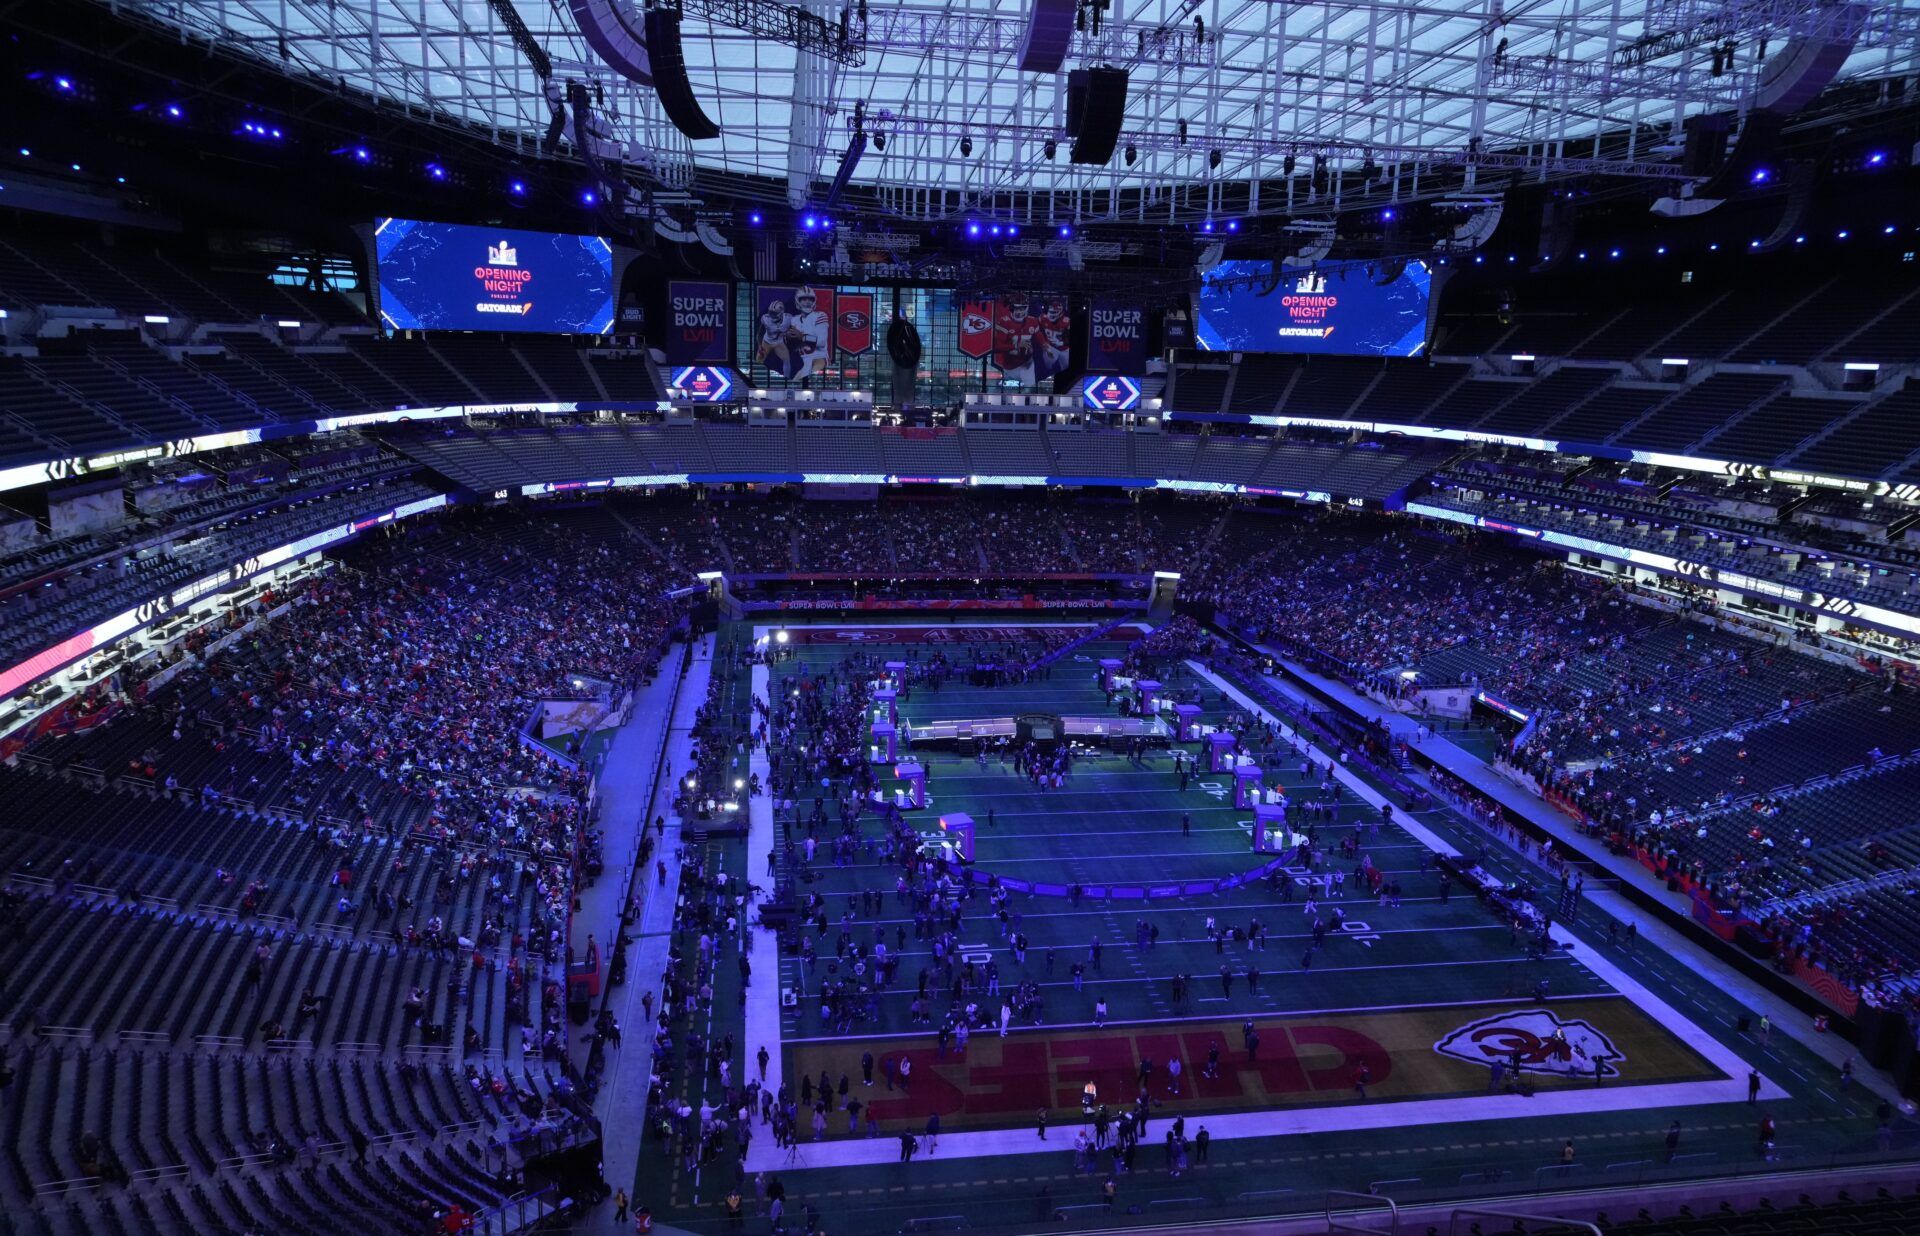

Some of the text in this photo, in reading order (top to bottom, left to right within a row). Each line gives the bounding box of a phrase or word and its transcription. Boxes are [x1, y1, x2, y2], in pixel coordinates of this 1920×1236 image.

[475, 267, 531, 281] OPENING
[485, 280, 522, 292] NIGHT
[673, 296, 725, 312] SUPER
[1282, 296, 1337, 307] OPENING
[476, 303, 523, 314] GATORADE
[1290, 306, 1327, 318] NIGHT
[674, 312, 724, 327] BOWL
[1092, 310, 1141, 324] SUPER
[682, 328, 715, 342] LVIII
[1093, 325, 1140, 338] BOWL
[1279, 327, 1324, 337] GATORADE
[1100, 338, 1131, 352] LVIII
[116, 454, 123, 462] TO
[1770, 470, 1803, 481] WELCOME
[1815, 476, 1845, 487] OPENING
[1846, 481, 1870, 490] NIGHT
[495, 489, 508, 499] 4:43
[1348, 497, 1363, 507] 4:43
[1718, 573, 1803, 600] WELCOME TO OPENING NIGHT
[788, 601, 855, 609] SUPER BOWL LVIII
